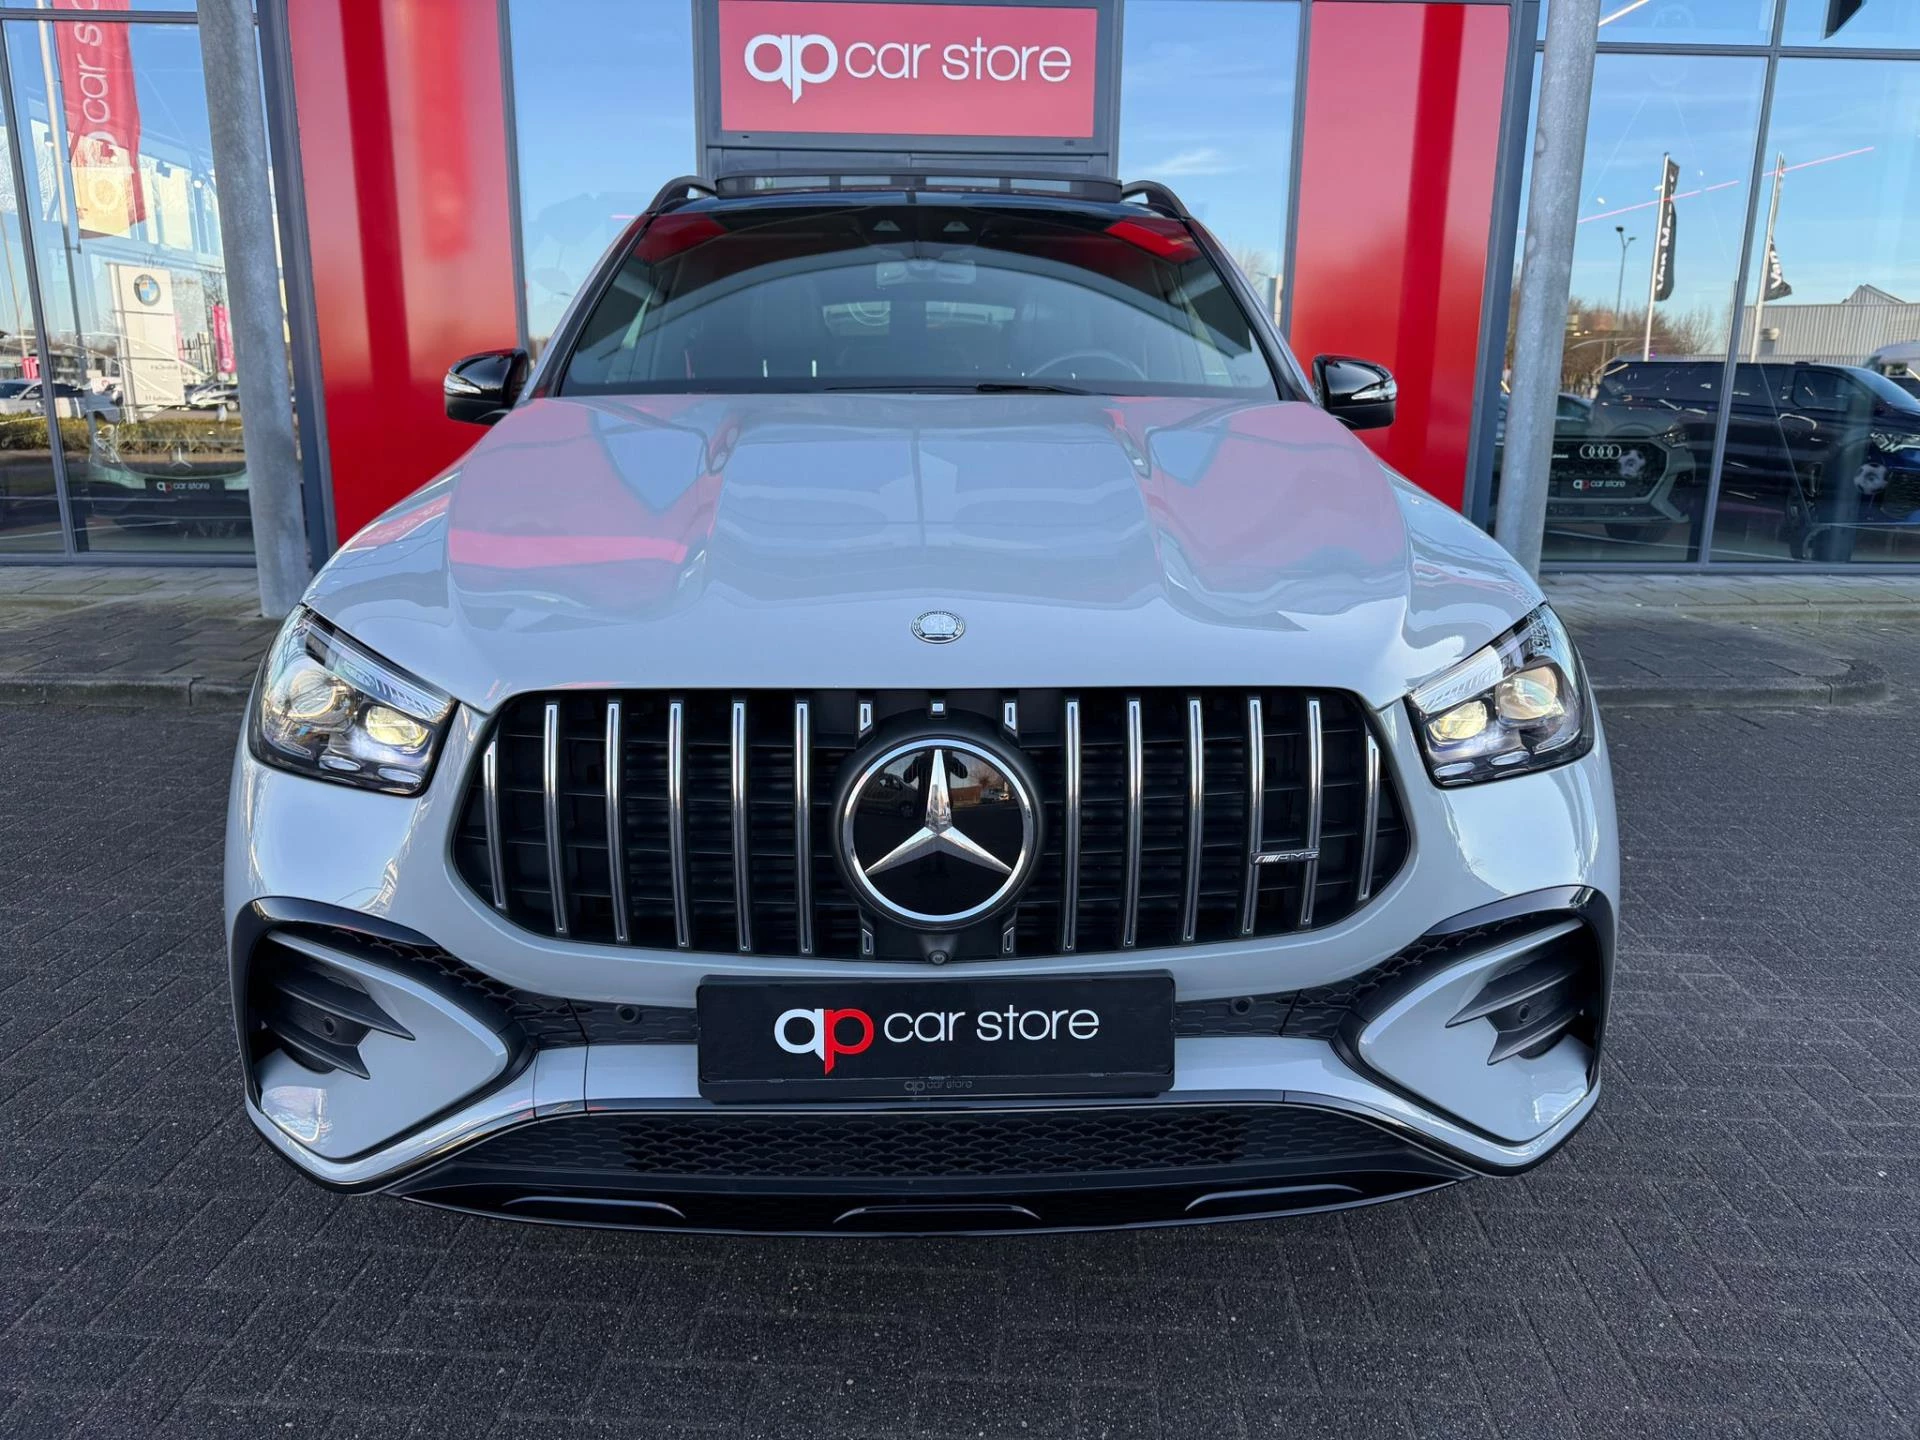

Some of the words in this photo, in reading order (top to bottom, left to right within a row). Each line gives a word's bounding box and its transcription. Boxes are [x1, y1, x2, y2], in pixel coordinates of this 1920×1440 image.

[76, 53, 111, 124] car
[744, 34, 838, 103] ap
[845, 41, 931, 80] car
[941, 37, 1072, 83] store
[773, 1008, 875, 1076] ap
[883, 1010, 966, 1043] car
[975, 1004, 1100, 1042] store
